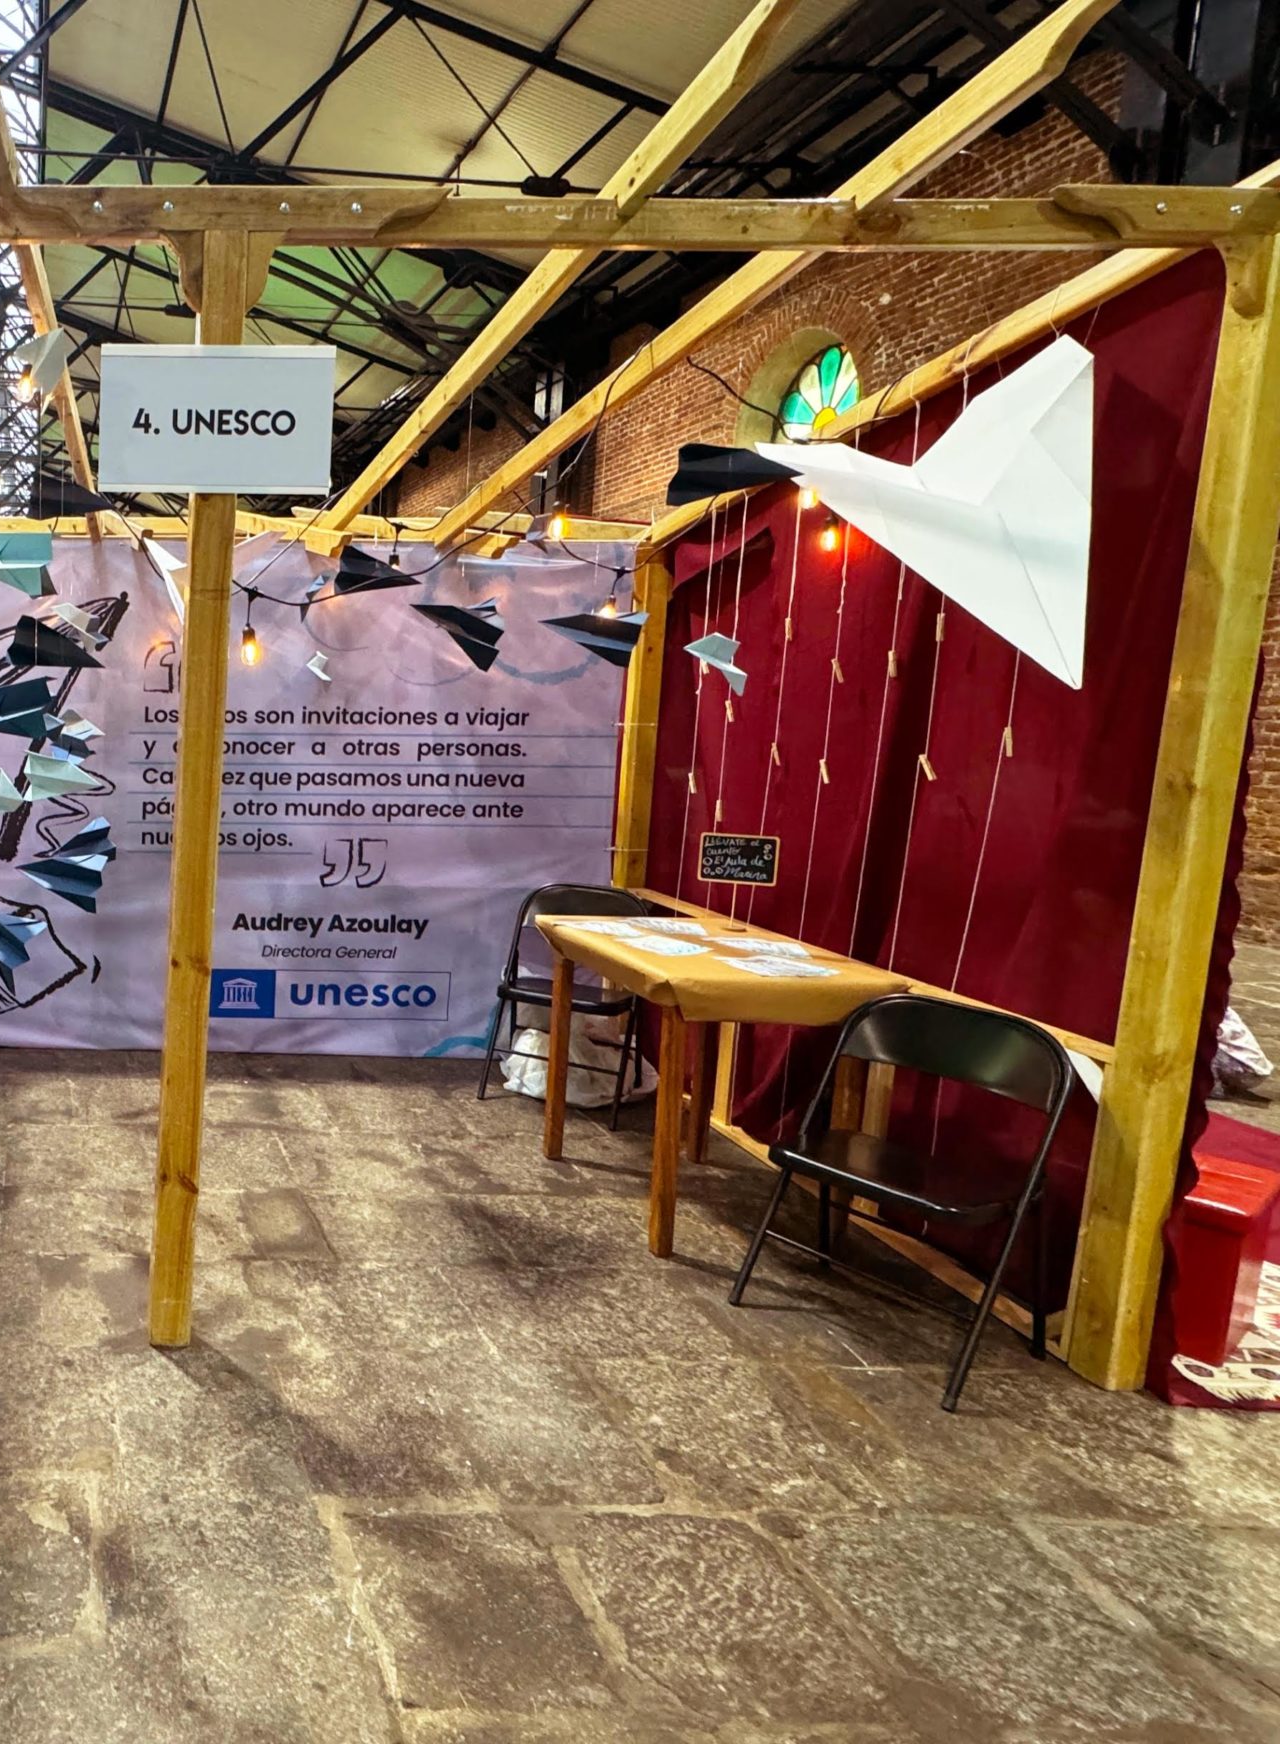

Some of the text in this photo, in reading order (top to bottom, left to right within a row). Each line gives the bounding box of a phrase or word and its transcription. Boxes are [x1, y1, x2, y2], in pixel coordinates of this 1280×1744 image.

[132, 408, 296, 436] 4. UNESCO
[254, 710, 294, 724] son
[302, 705, 438, 725] invitaciones
[444, 710, 459, 725] a
[466, 706, 530, 732] viajar
[143, 739, 156, 759] y
[312, 741, 326, 755] a
[343, 739, 401, 757] otras
[417, 741, 527, 761] personas.
[249, 771, 292, 790] que
[296, 771, 401, 791] pasamos
[407, 772, 449, 787] una
[455, 772, 525, 788] nueva
[233, 798, 524, 822] otro mundo aparece ante
[243, 827, 293, 852] ojos.
[232, 913, 429, 940] Audrey Azoulay
[261, 944, 397, 959] Directora General
[290, 982, 437, 1008] unesco
